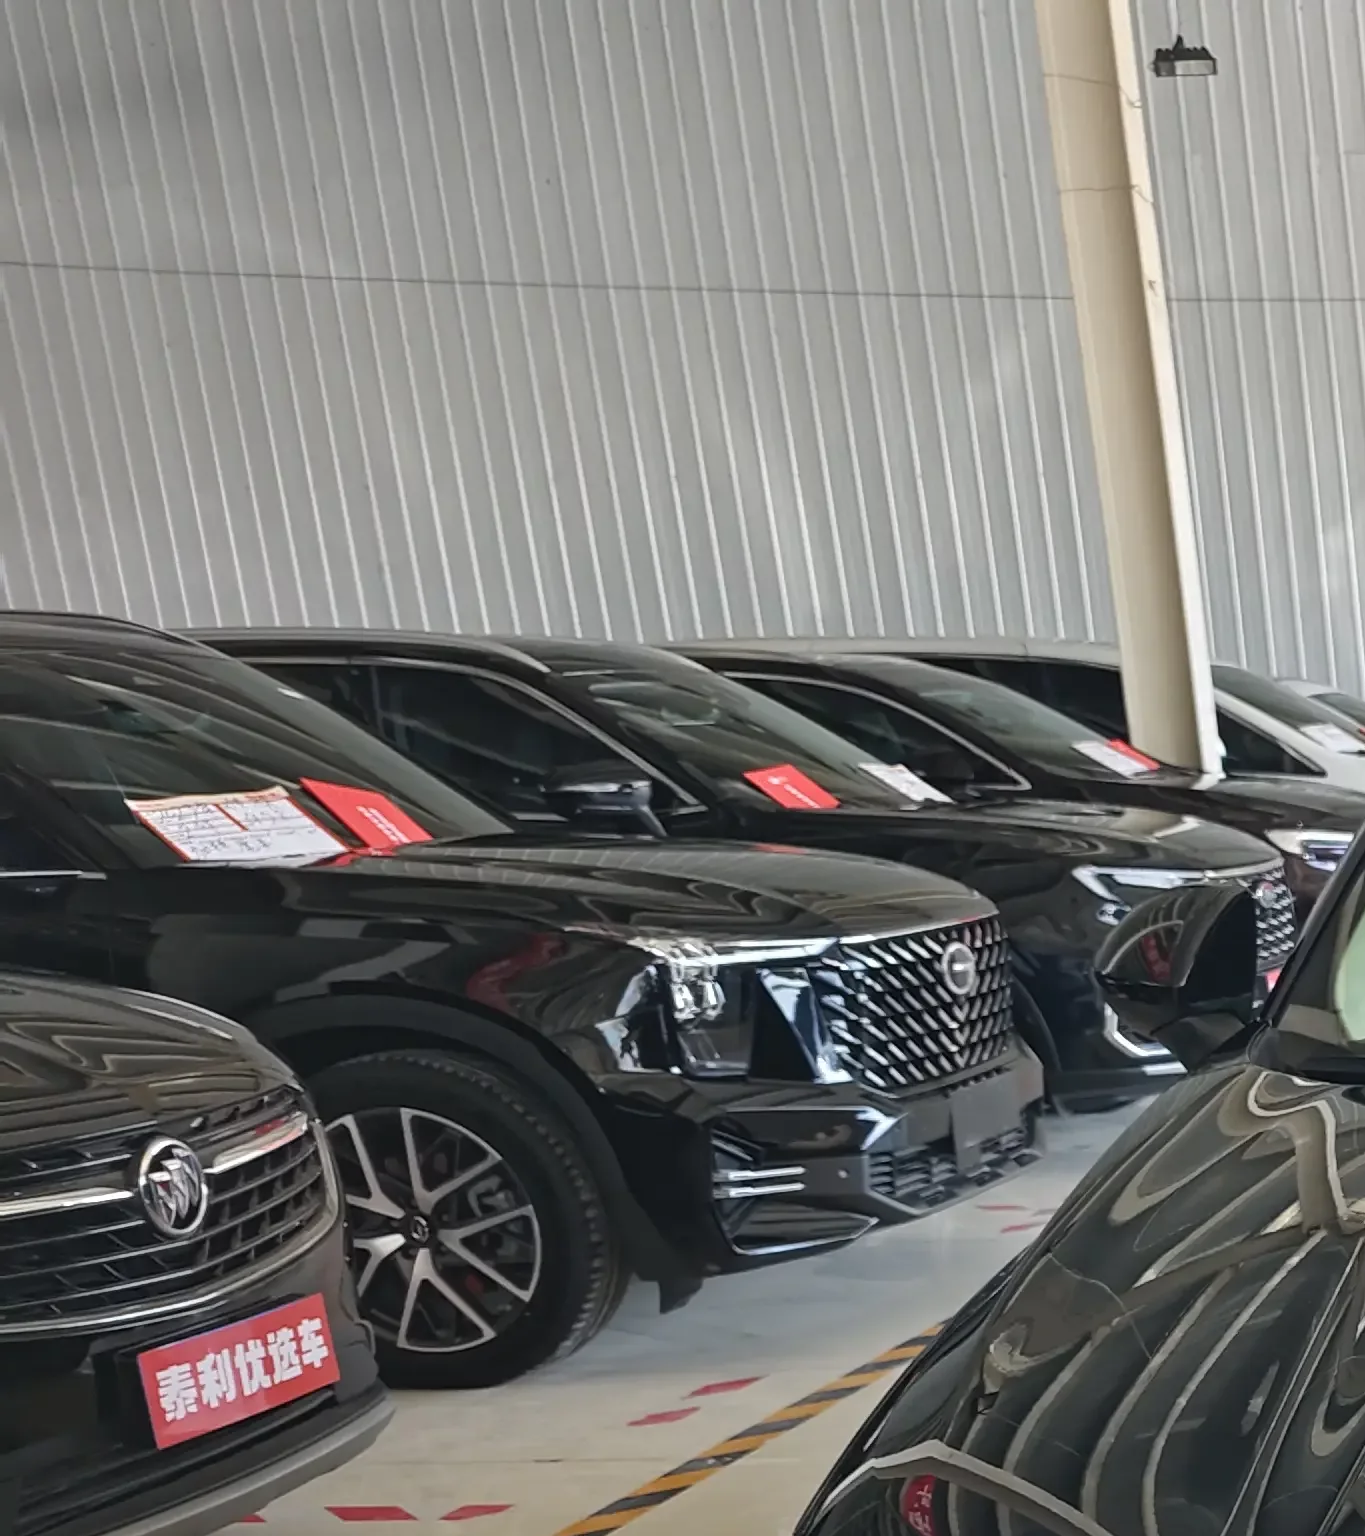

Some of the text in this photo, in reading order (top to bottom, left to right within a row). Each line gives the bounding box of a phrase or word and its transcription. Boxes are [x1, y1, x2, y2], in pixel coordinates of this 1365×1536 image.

[155, 1317, 329, 1422] 泰利优选车
